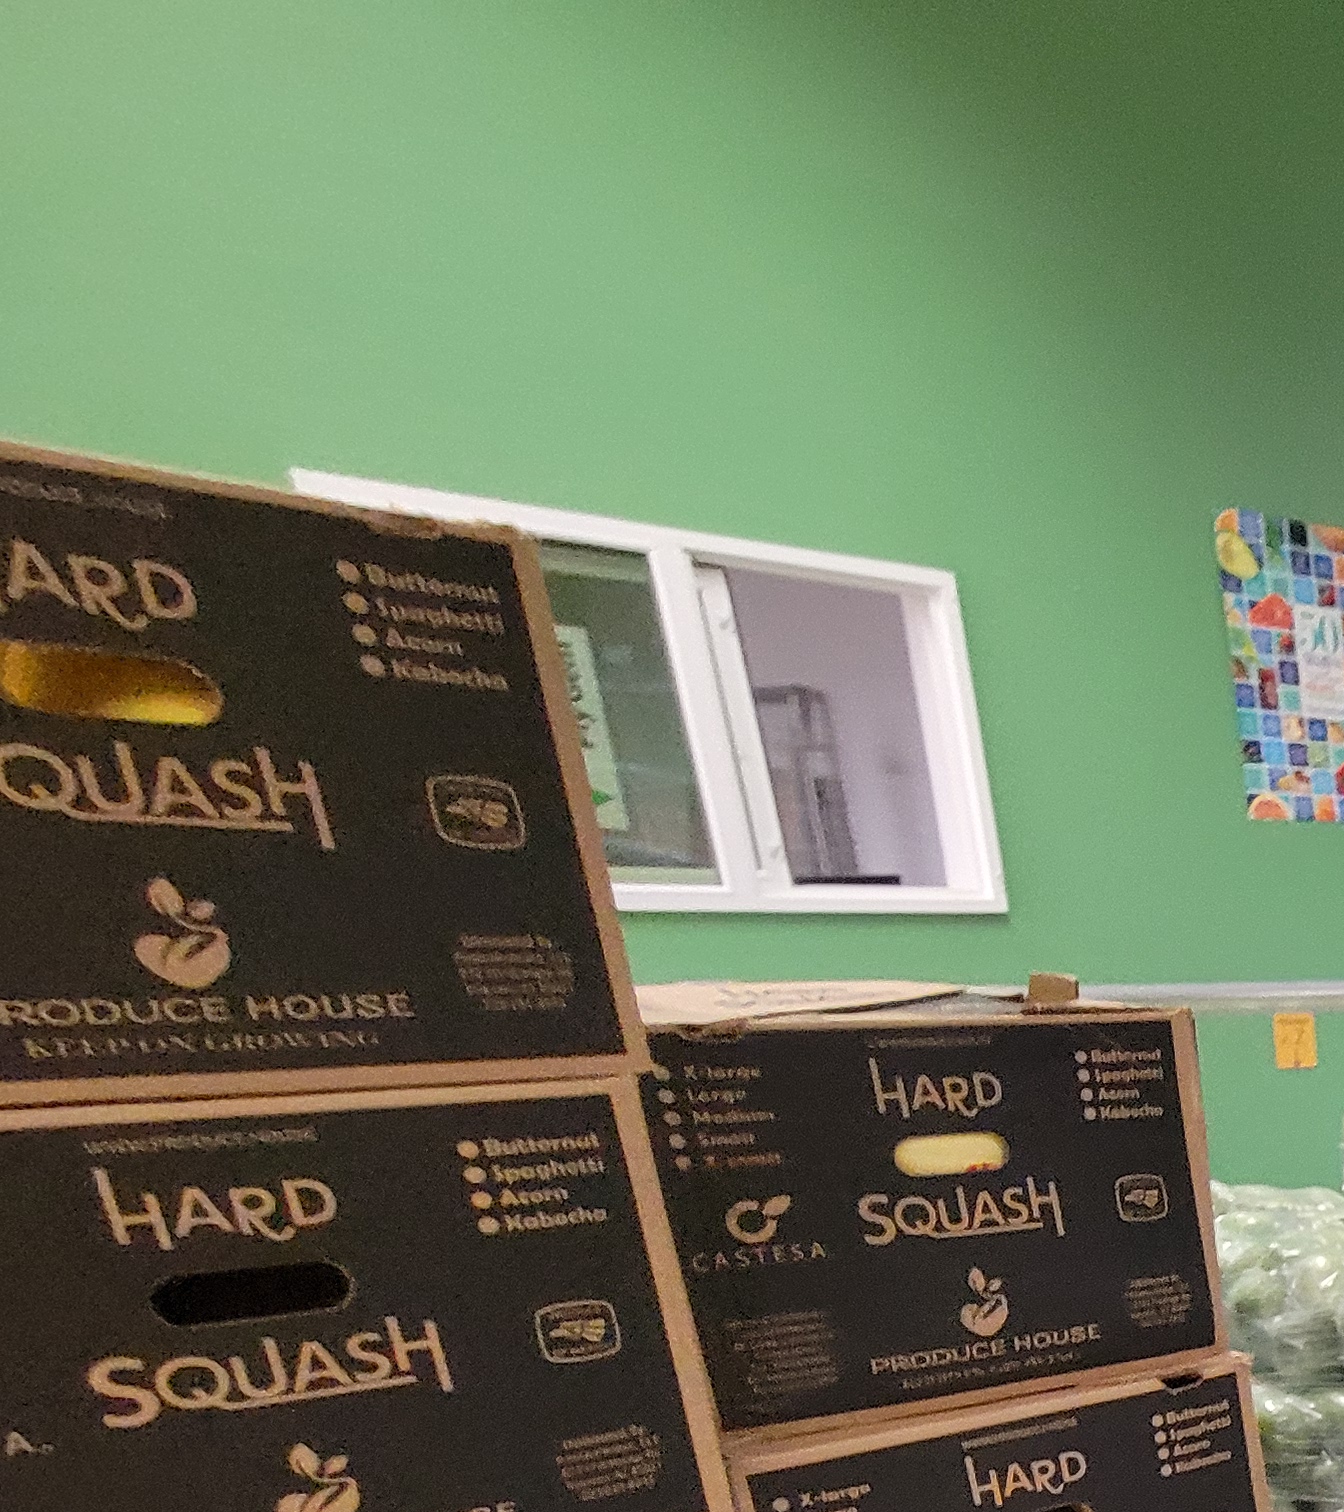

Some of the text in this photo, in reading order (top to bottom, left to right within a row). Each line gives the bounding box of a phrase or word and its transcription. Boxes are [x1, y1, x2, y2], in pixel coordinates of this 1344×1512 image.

[4, 538, 198, 633] ARD
[0, 741, 335, 851] QUASH
[0, 992, 416, 1027] RODUCE HOUSE
[868, 1056, 1003, 1120] HARD
[92, 1166, 338, 1251] HARD
[857, 1174, 1065, 1247] SQUASH
[692, 1241, 827, 1273] CASTESA
[87, 1315, 455, 1429] SQUASH
[870, 1338, 1005, 1376] PRODUCE
[1014, 1323, 1103, 1353] HOUSE
[963, 1450, 1086, 1508] HARD
